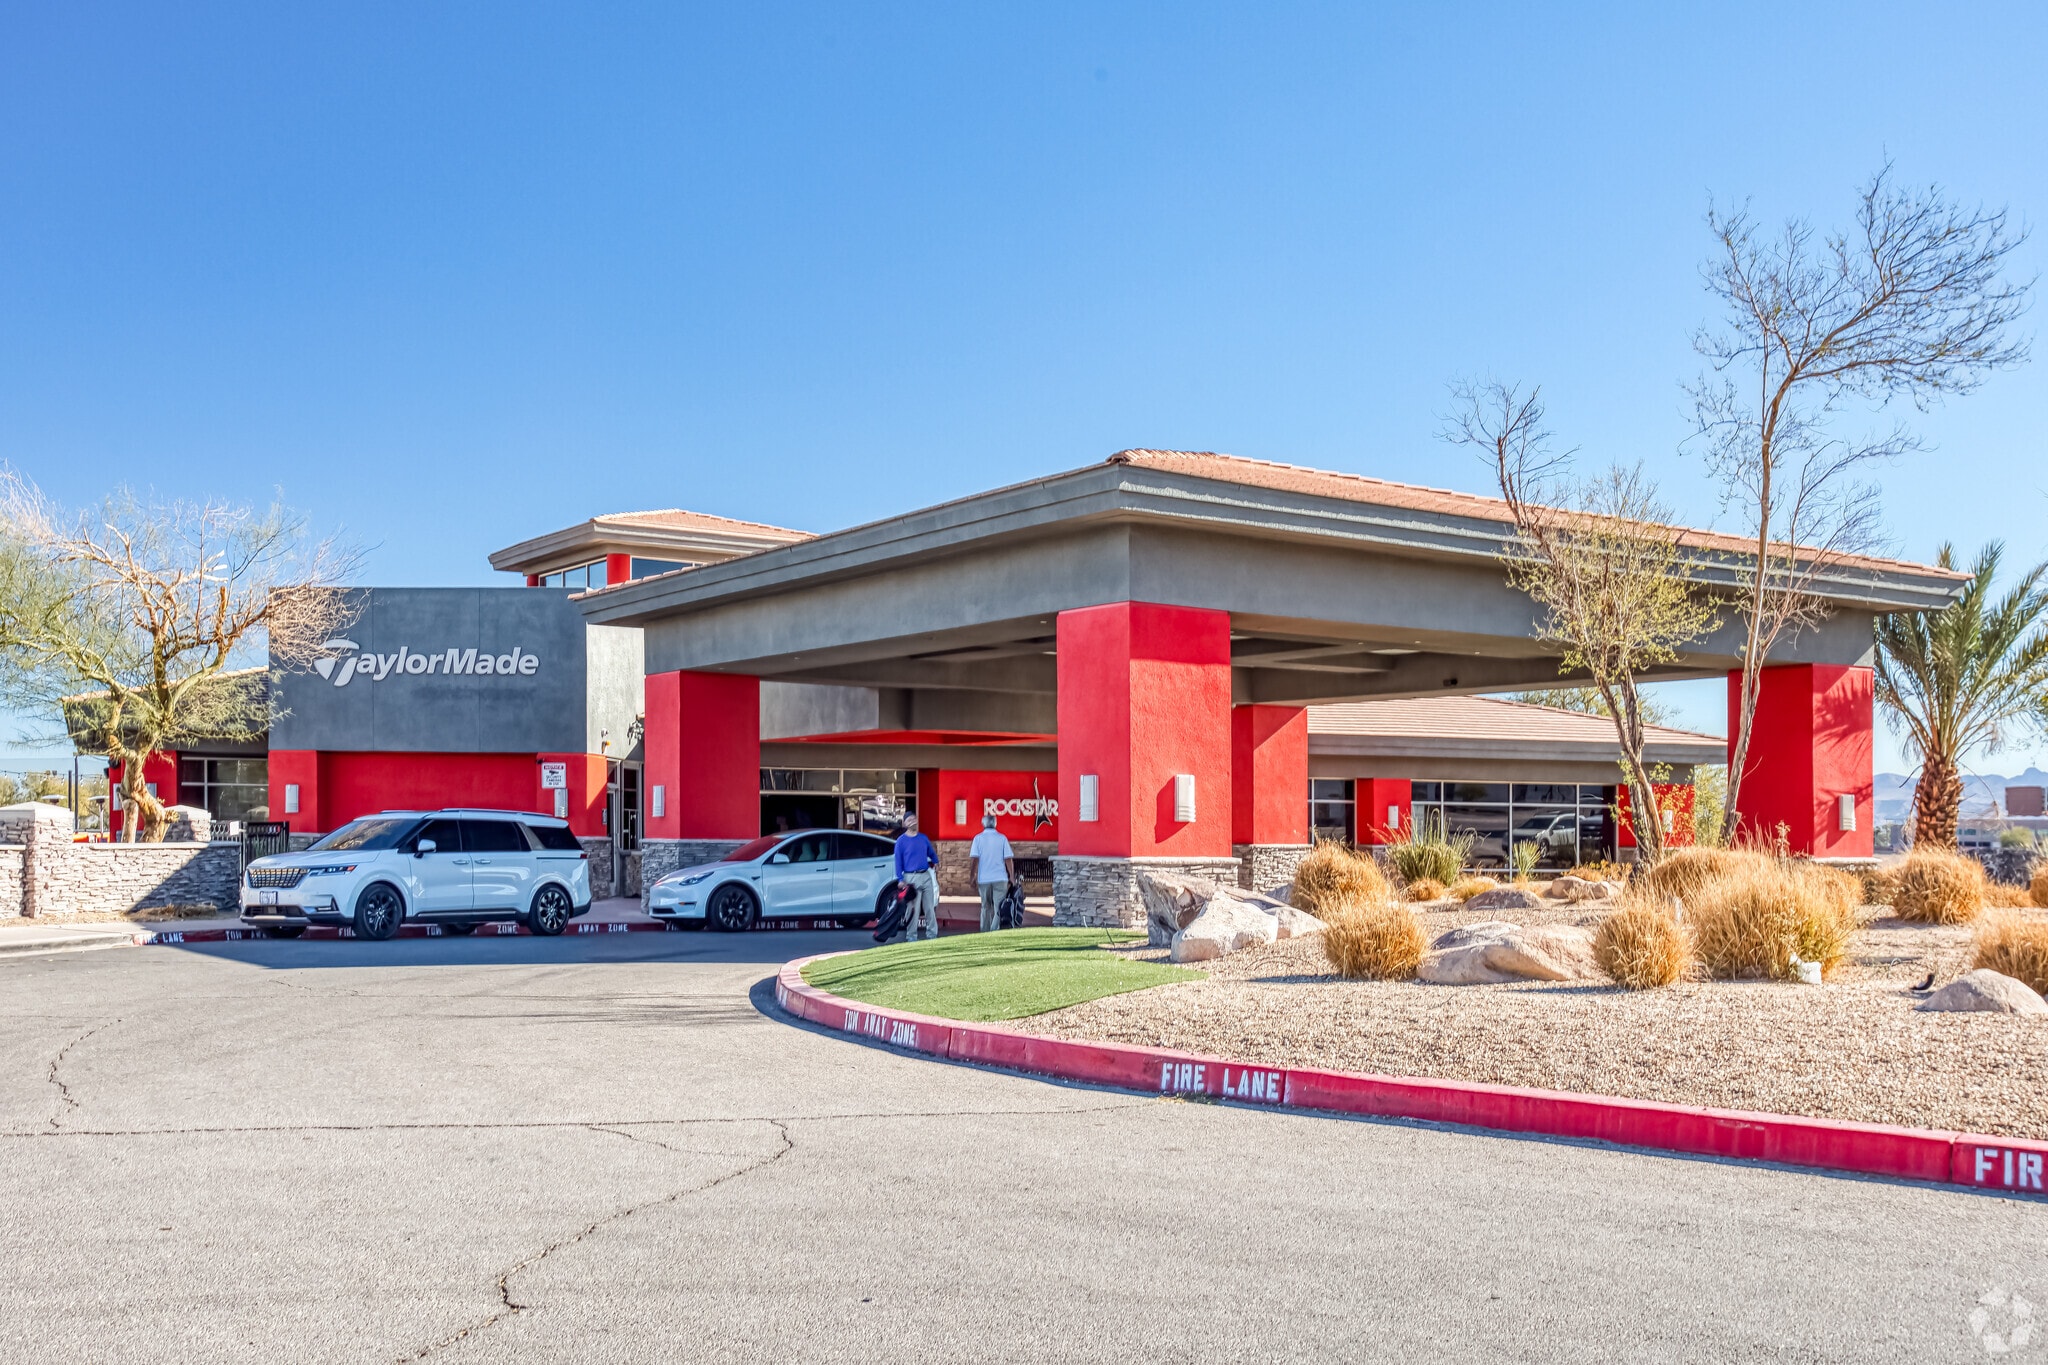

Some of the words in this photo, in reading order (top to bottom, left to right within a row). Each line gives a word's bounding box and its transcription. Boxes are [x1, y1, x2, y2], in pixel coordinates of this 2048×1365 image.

[314, 638, 539, 687] TaylorMade
[984, 798, 1058, 816] ROCKSTAR
[426, 926, 442, 936] TOW
[497, 924, 518, 934] ZONE
[578, 923, 599, 932] AWAY
[608, 923, 628, 932] ZONE
[755, 921, 775, 929] AWAY
[780, 921, 799, 929] ZONE
[813, 920, 831, 929] FIRE
[162, 932, 184, 943] LANE
[225, 930, 242, 941] TOW
[845, 1009, 859, 1031] TOW
[864, 1012, 887, 1037] AWAY
[890, 1020, 917, 1047] ZONE
[1161, 1062, 1206, 1091] FIRE
[1223, 1067, 1280, 1099] LANE
[1975, 1147, 2043, 1190] FIR
